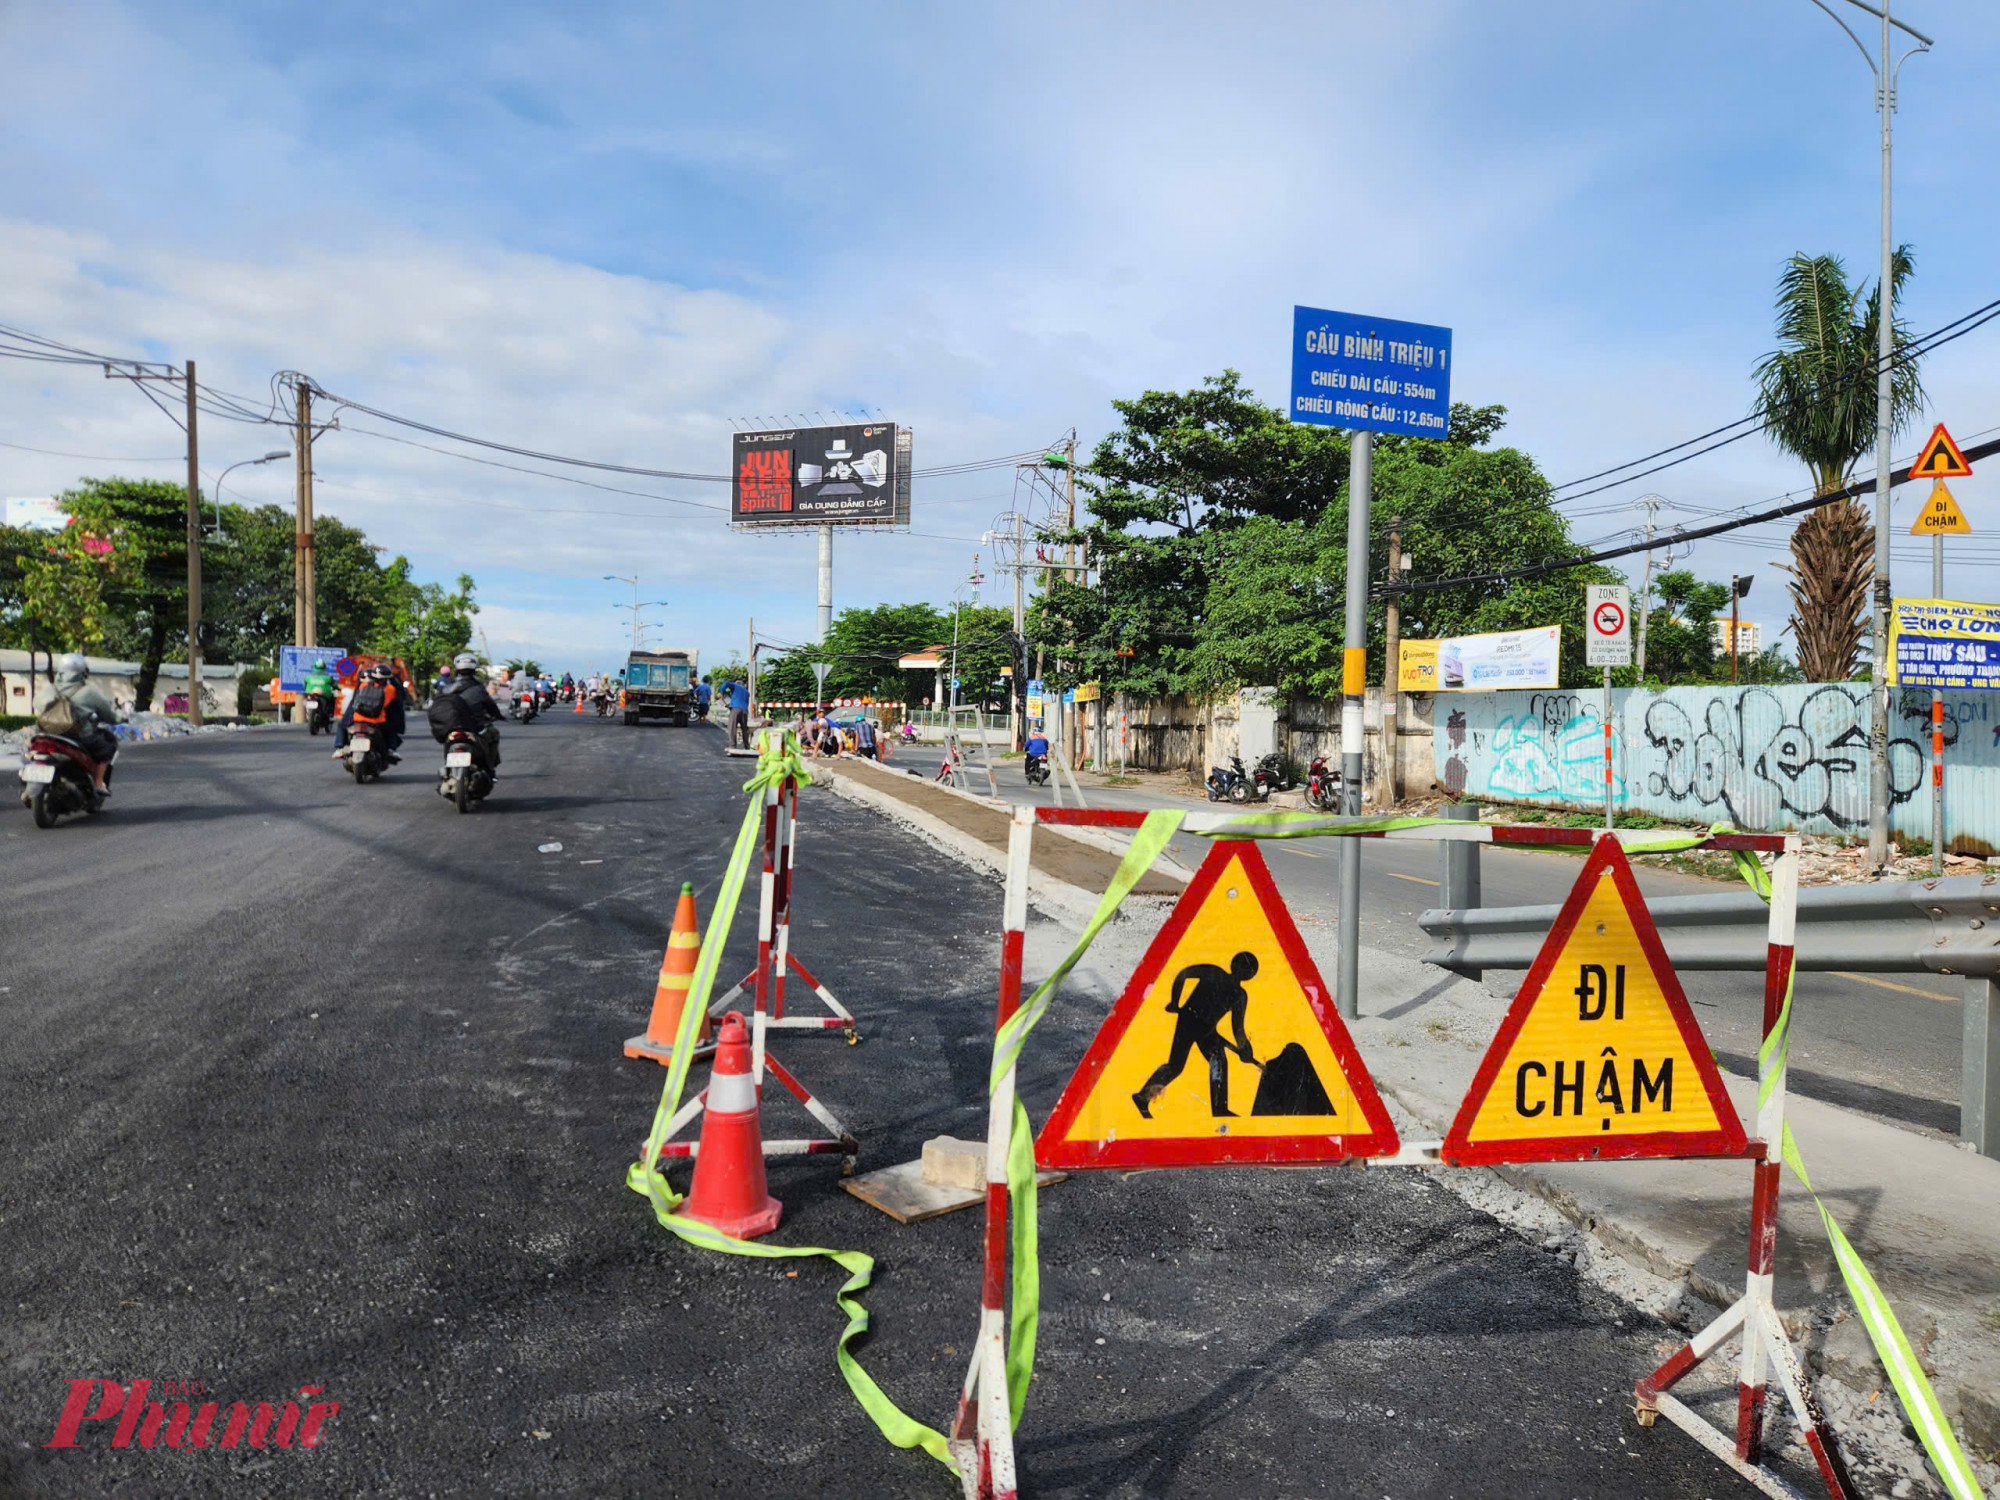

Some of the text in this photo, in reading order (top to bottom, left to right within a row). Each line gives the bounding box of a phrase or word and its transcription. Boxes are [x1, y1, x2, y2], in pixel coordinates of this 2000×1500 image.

[1306, 324, 1446, 372] CẦU BÌNH TRIỆU 1
[1311, 369, 1347, 389] CHIỀU
[1350, 373, 1370, 391] DÀI
[1404, 382, 1436, 400] 554m
[1296, 394, 1332, 414] CHIỀU
[1335, 398, 1369, 420] RỘNG
[1402, 410, 1444, 429] 12,65m
[740, 450, 789, 472] JUN
[799, 501, 813, 510] GIA
[866, 496, 886, 507] CẤP
[1936, 501, 1947, 512] ĐI
[1925, 514, 1957, 529] CHẬM
[1598, 588, 1619, 599] ZONE
[1920, 618, 1954, 634] CHỢ
[1926, 642, 1954, 661] THỨ
[1956, 643, 1987, 662] SÁU
[1574, 964, 1625, 1021] ĐI
[1515, 1046, 1674, 1131] CHẬM
